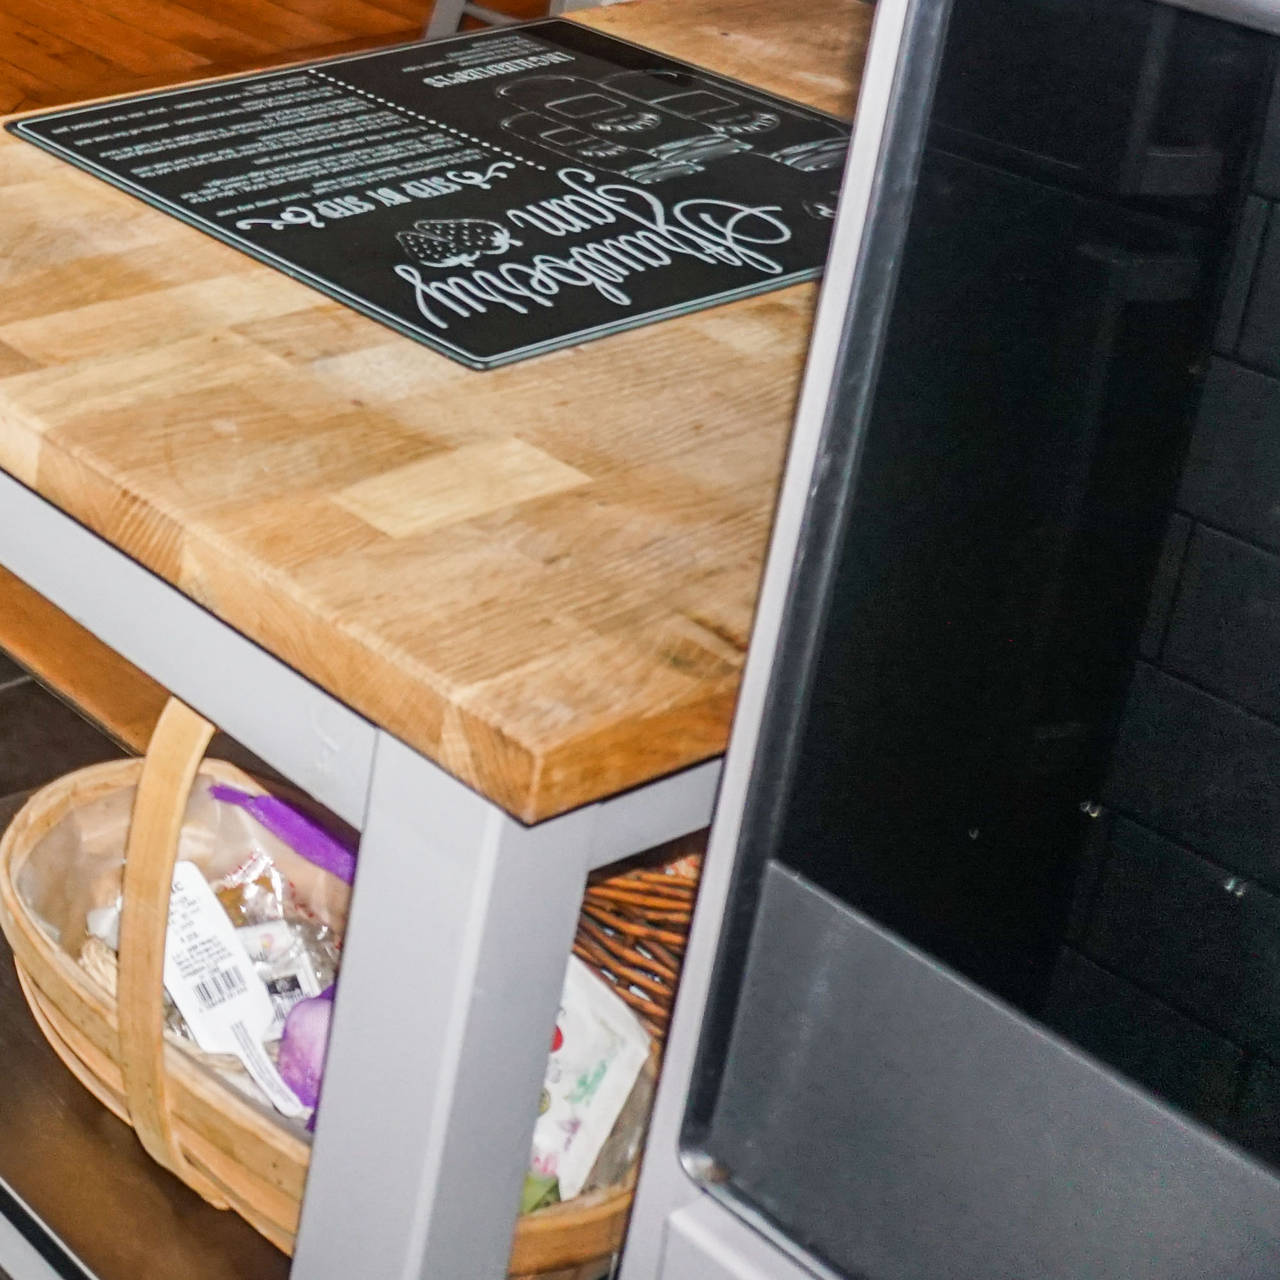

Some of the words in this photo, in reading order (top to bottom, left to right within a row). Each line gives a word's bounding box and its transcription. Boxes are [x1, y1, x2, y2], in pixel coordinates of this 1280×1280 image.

[369, 188, 412, 207] BY
[402, 175, 463, 200] STEP
[316, 195, 376, 220] STEP
[506, 167, 666, 237] Jam
[393, 198, 793, 329] Strawberry
